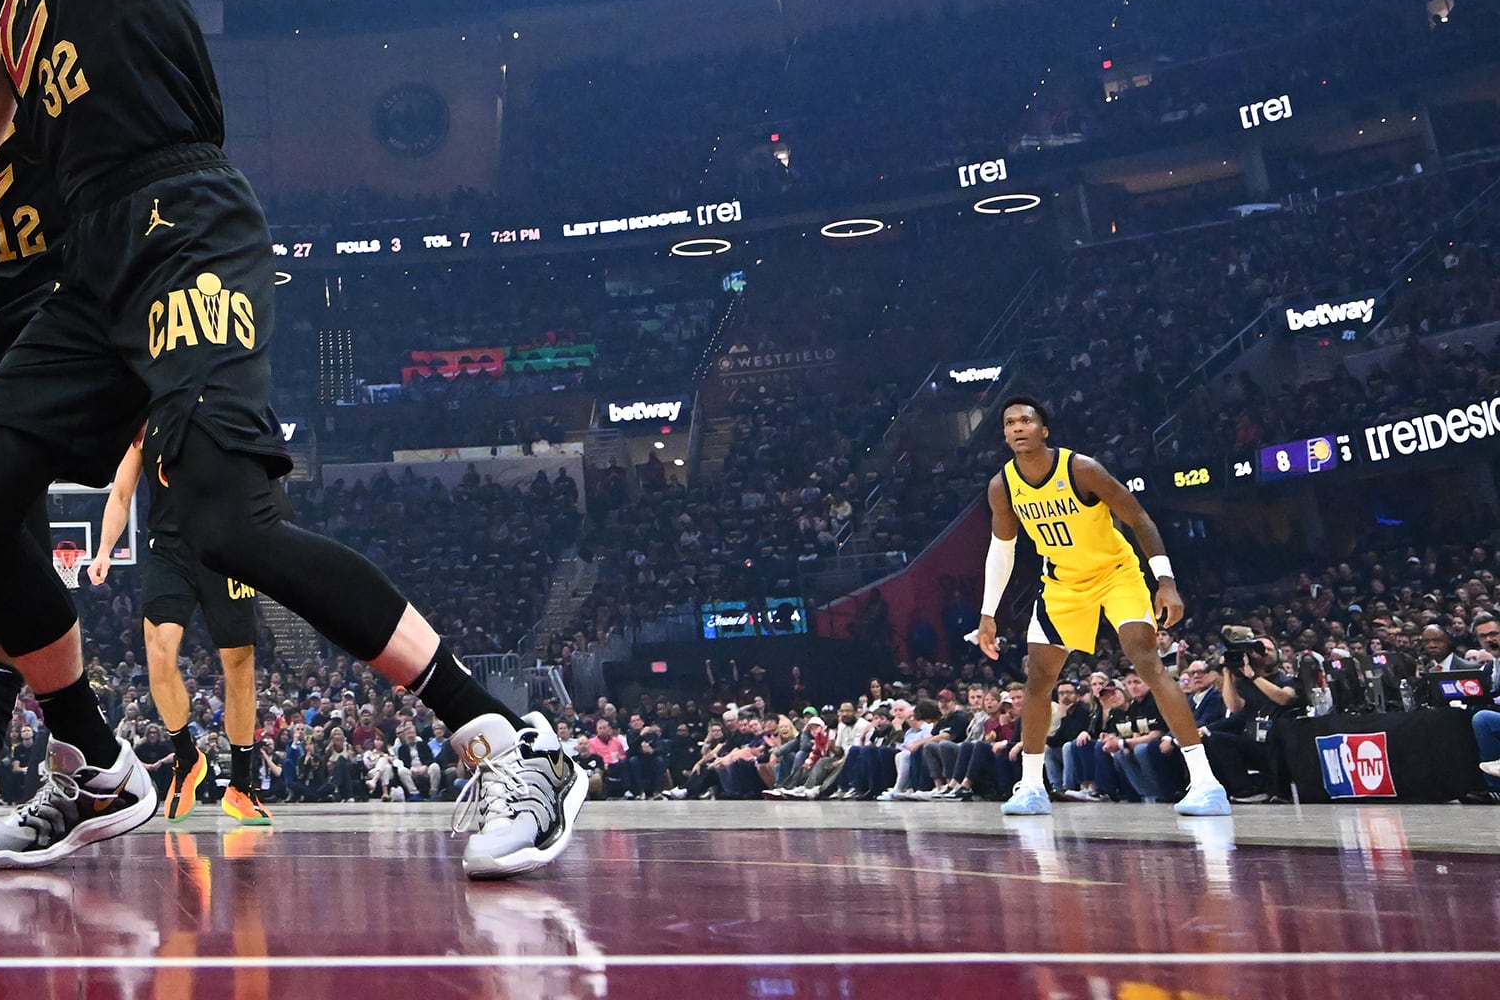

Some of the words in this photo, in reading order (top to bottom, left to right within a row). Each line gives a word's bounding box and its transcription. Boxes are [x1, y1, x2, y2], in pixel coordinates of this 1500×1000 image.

[38, 39, 90, 118] 32
[293, 243, 312, 257] 27
[336, 239, 380, 254] FOULS
[391, 237, 401, 252] 3
[423, 235, 451, 248] TOL
[460, 232, 470, 247] 7
[491, 230, 517, 243] 7:21
[520, 228, 541, 241] PM
[148, 290, 255, 359] CAVS
[1287, 298, 1375, 331] betway
[737, 348, 836, 368] WESTFIELD
[608, 400, 682, 424] betway
[1276, 450, 1291, 472] 8
[1340, 445, 1352, 462] 3
[1126, 477, 1146, 493] 1Q
[1174, 468, 1210, 488] 5:28
[1233, 461, 1252, 477] 24
[1013, 497, 1080, 520] INDIANA
[1036, 521, 1073, 547] 00
[1357, 758, 1386, 777] TNT
